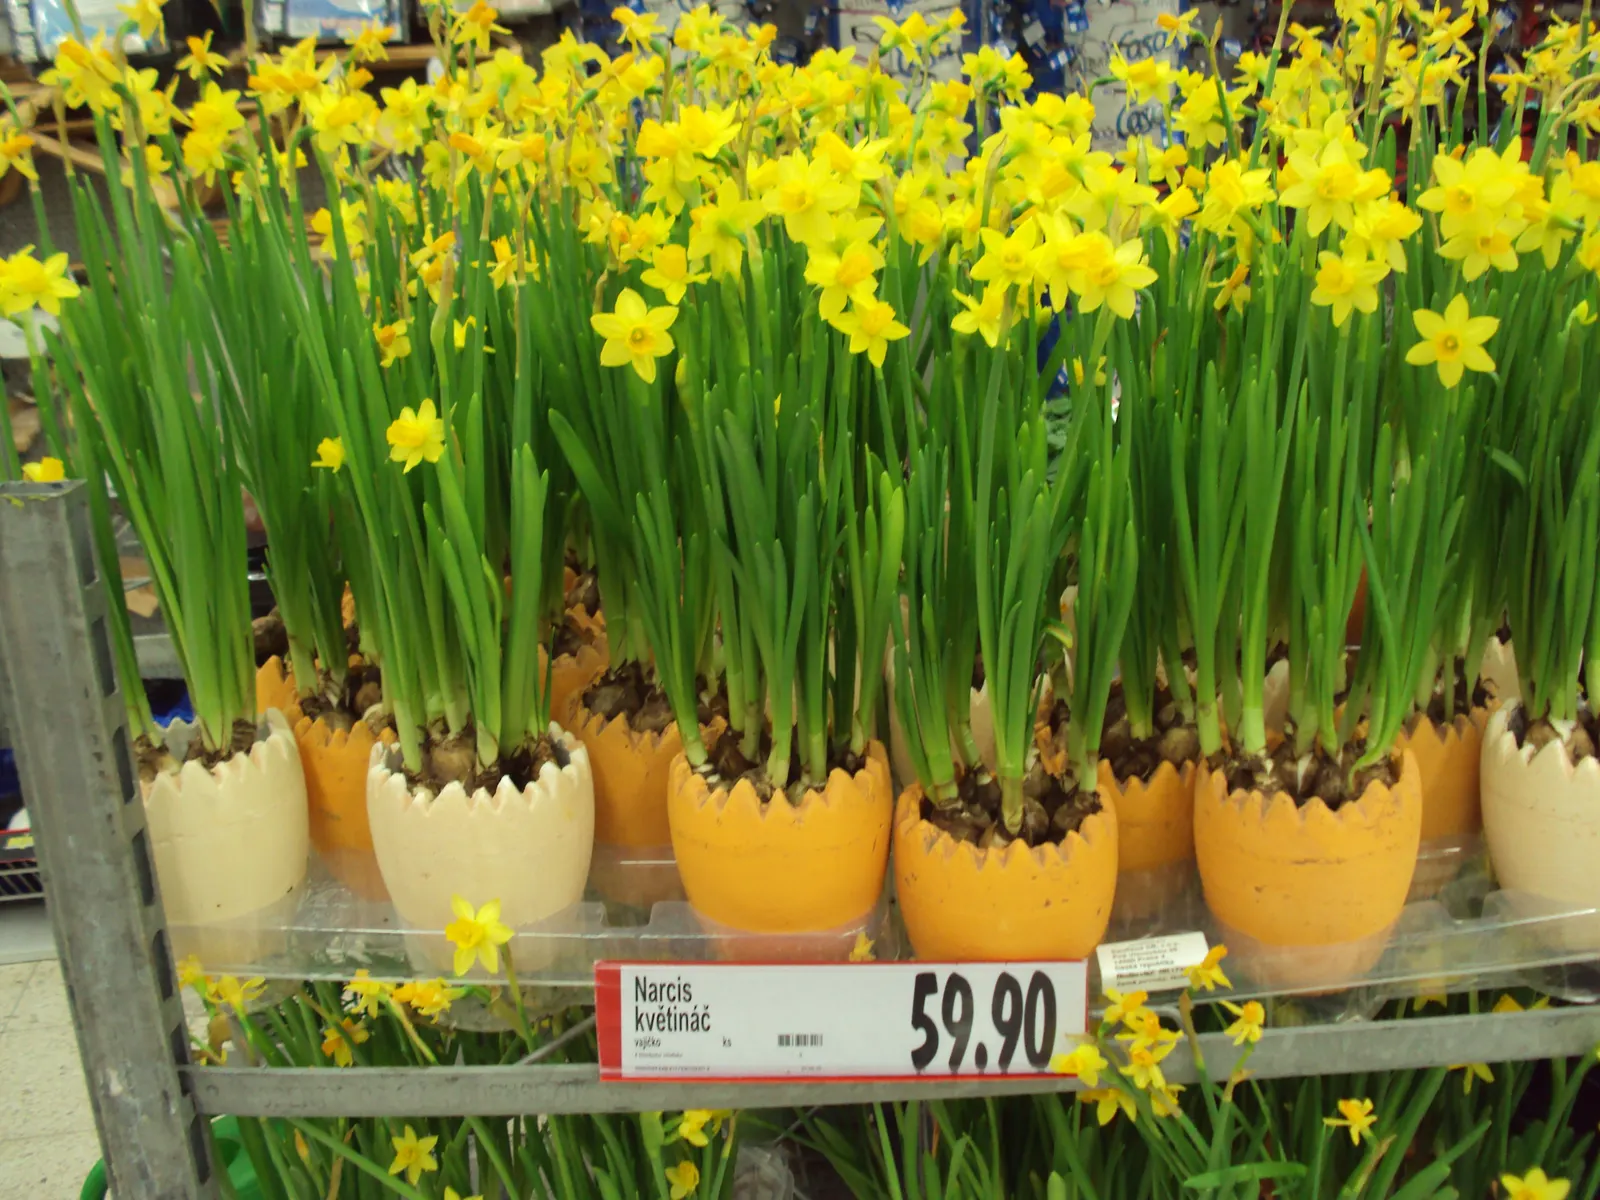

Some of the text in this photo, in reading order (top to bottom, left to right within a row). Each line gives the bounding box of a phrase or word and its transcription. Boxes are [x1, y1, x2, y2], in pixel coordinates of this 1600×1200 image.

[635, 976, 693, 1003] Narcis
[635, 1005, 712, 1033] květináč
[911, 970, 1057, 1073] 59.90
[722, 1036, 732, 1048] ks
